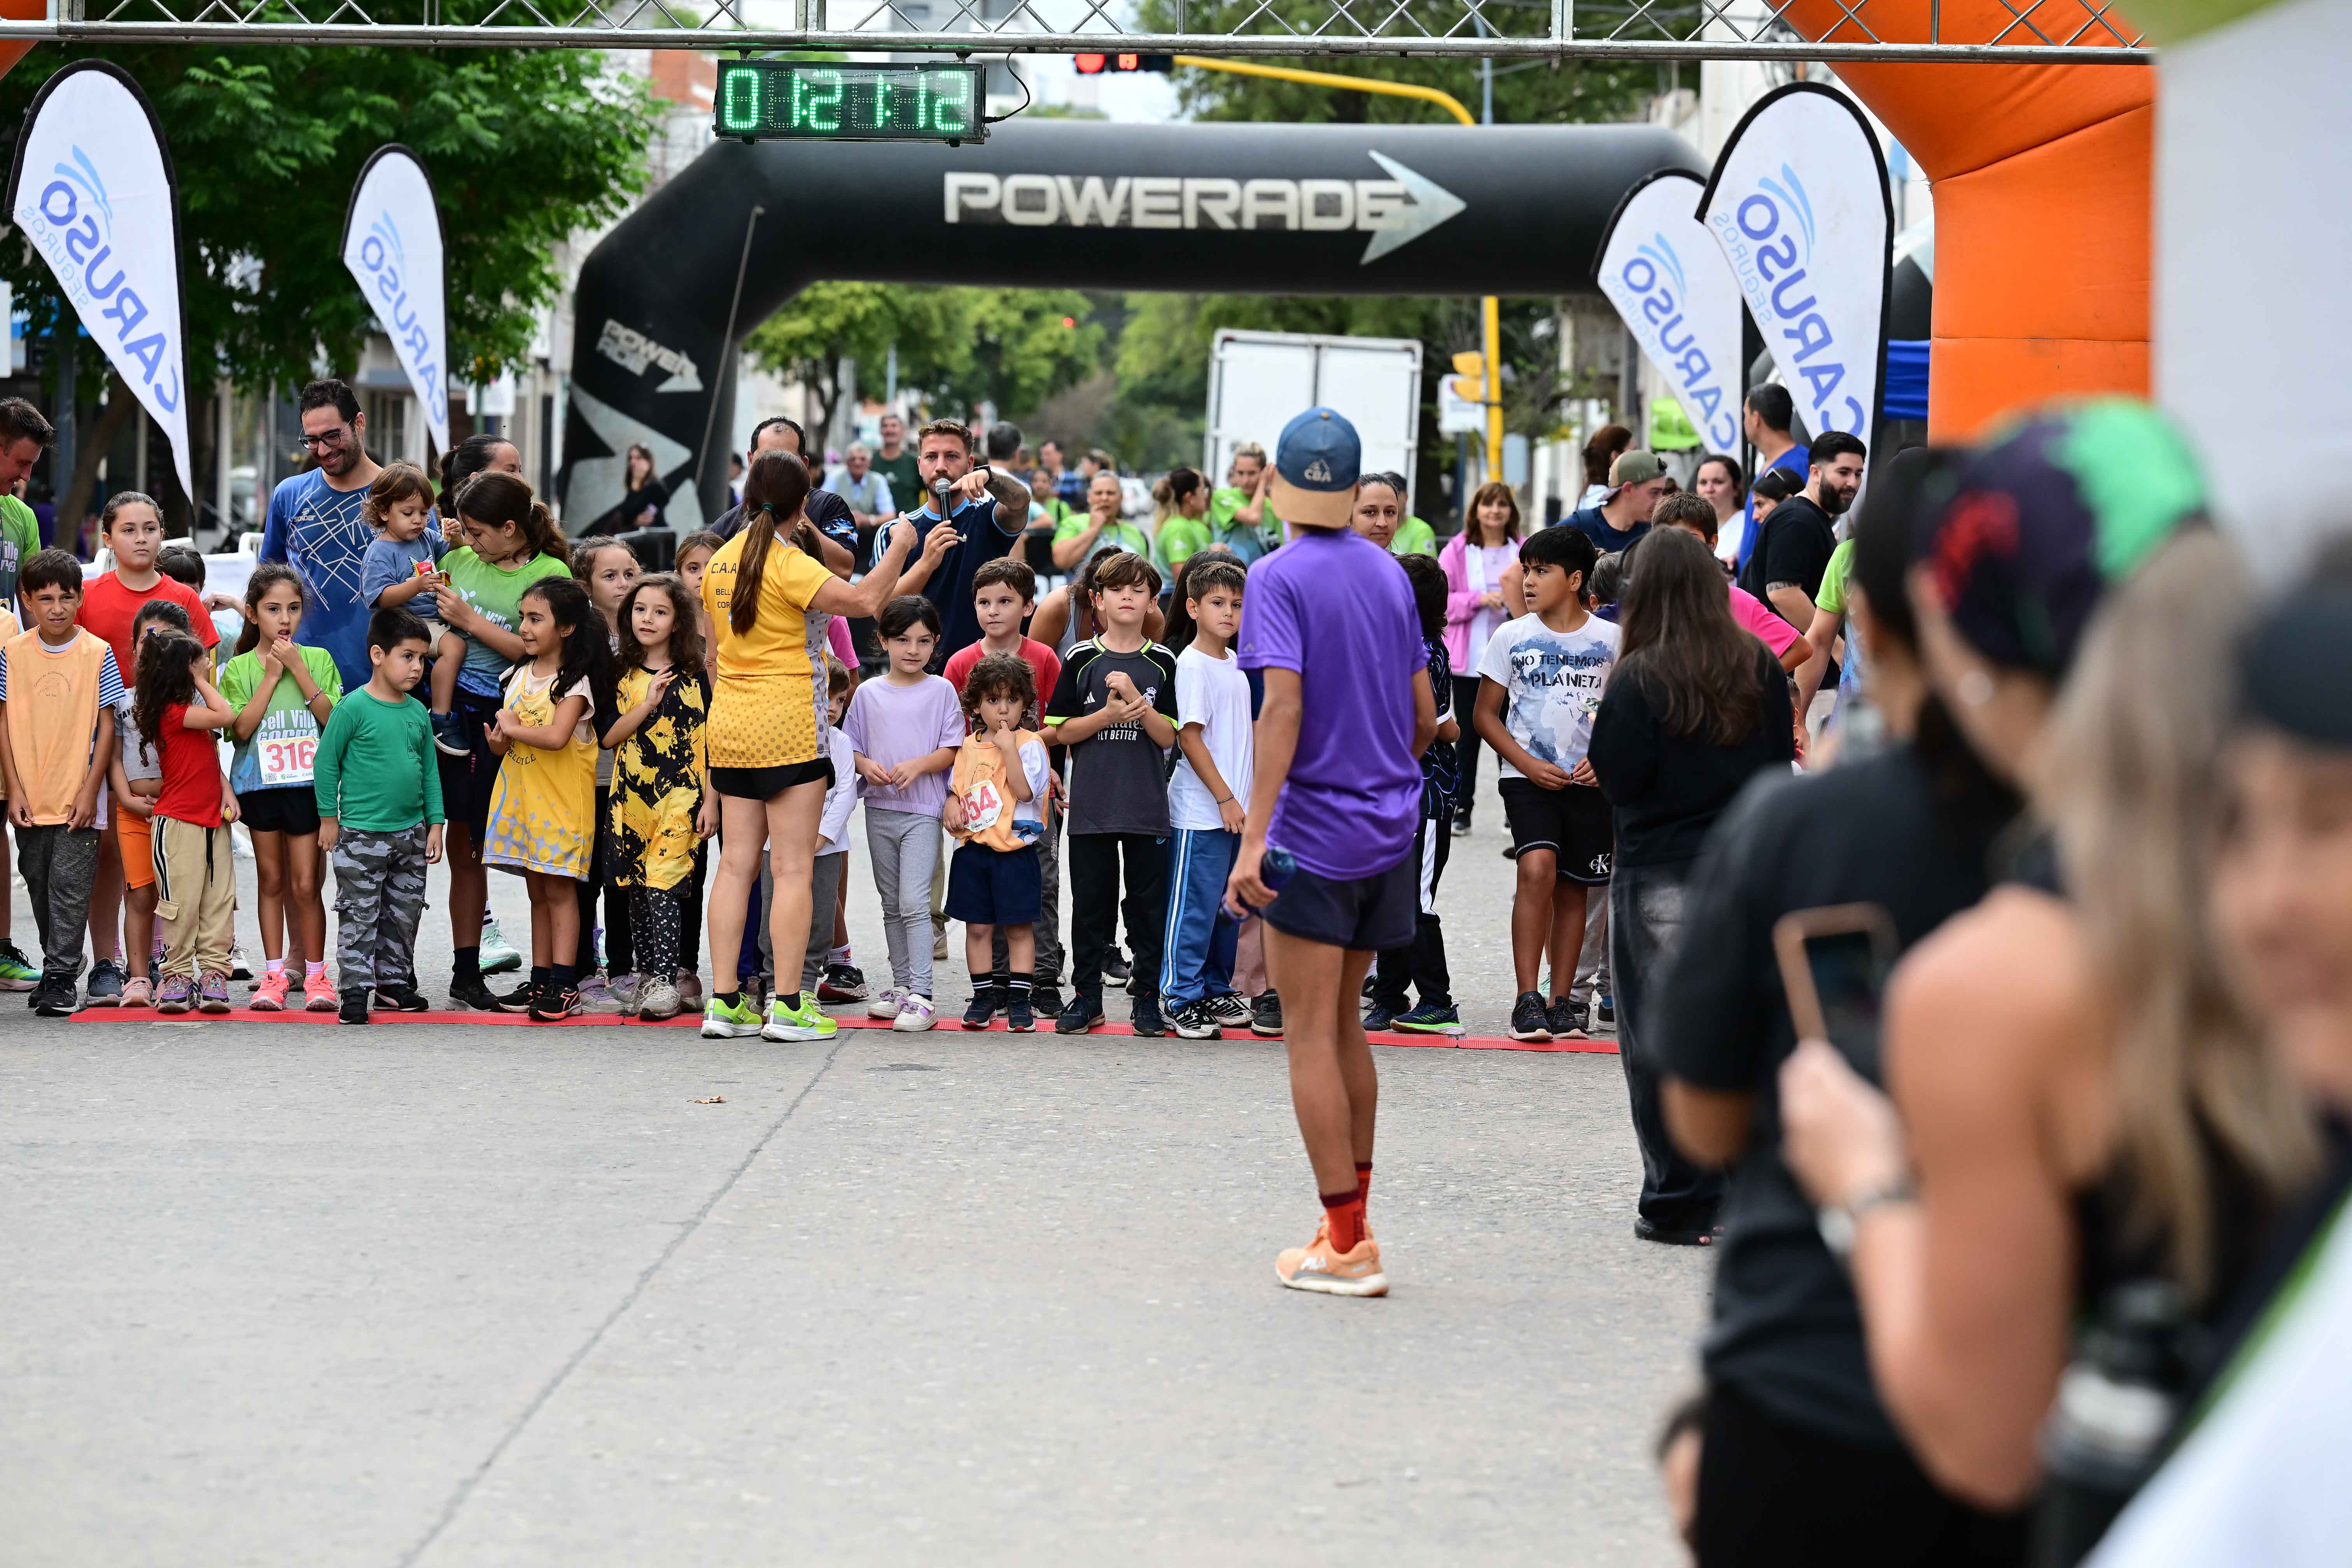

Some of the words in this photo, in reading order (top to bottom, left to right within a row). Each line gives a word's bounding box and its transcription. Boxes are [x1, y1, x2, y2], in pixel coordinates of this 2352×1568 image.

[944, 171, 1408, 231] POWERADE
[1516, 655, 1535, 666] NO
[1539, 654, 1604, 668] TENEMOS
[1098, 730, 1108, 740] FLY
[1110, 730, 1138, 741] BETTER
[266, 740, 315, 772] 316
[802, 1012, 821, 1024] FILA
